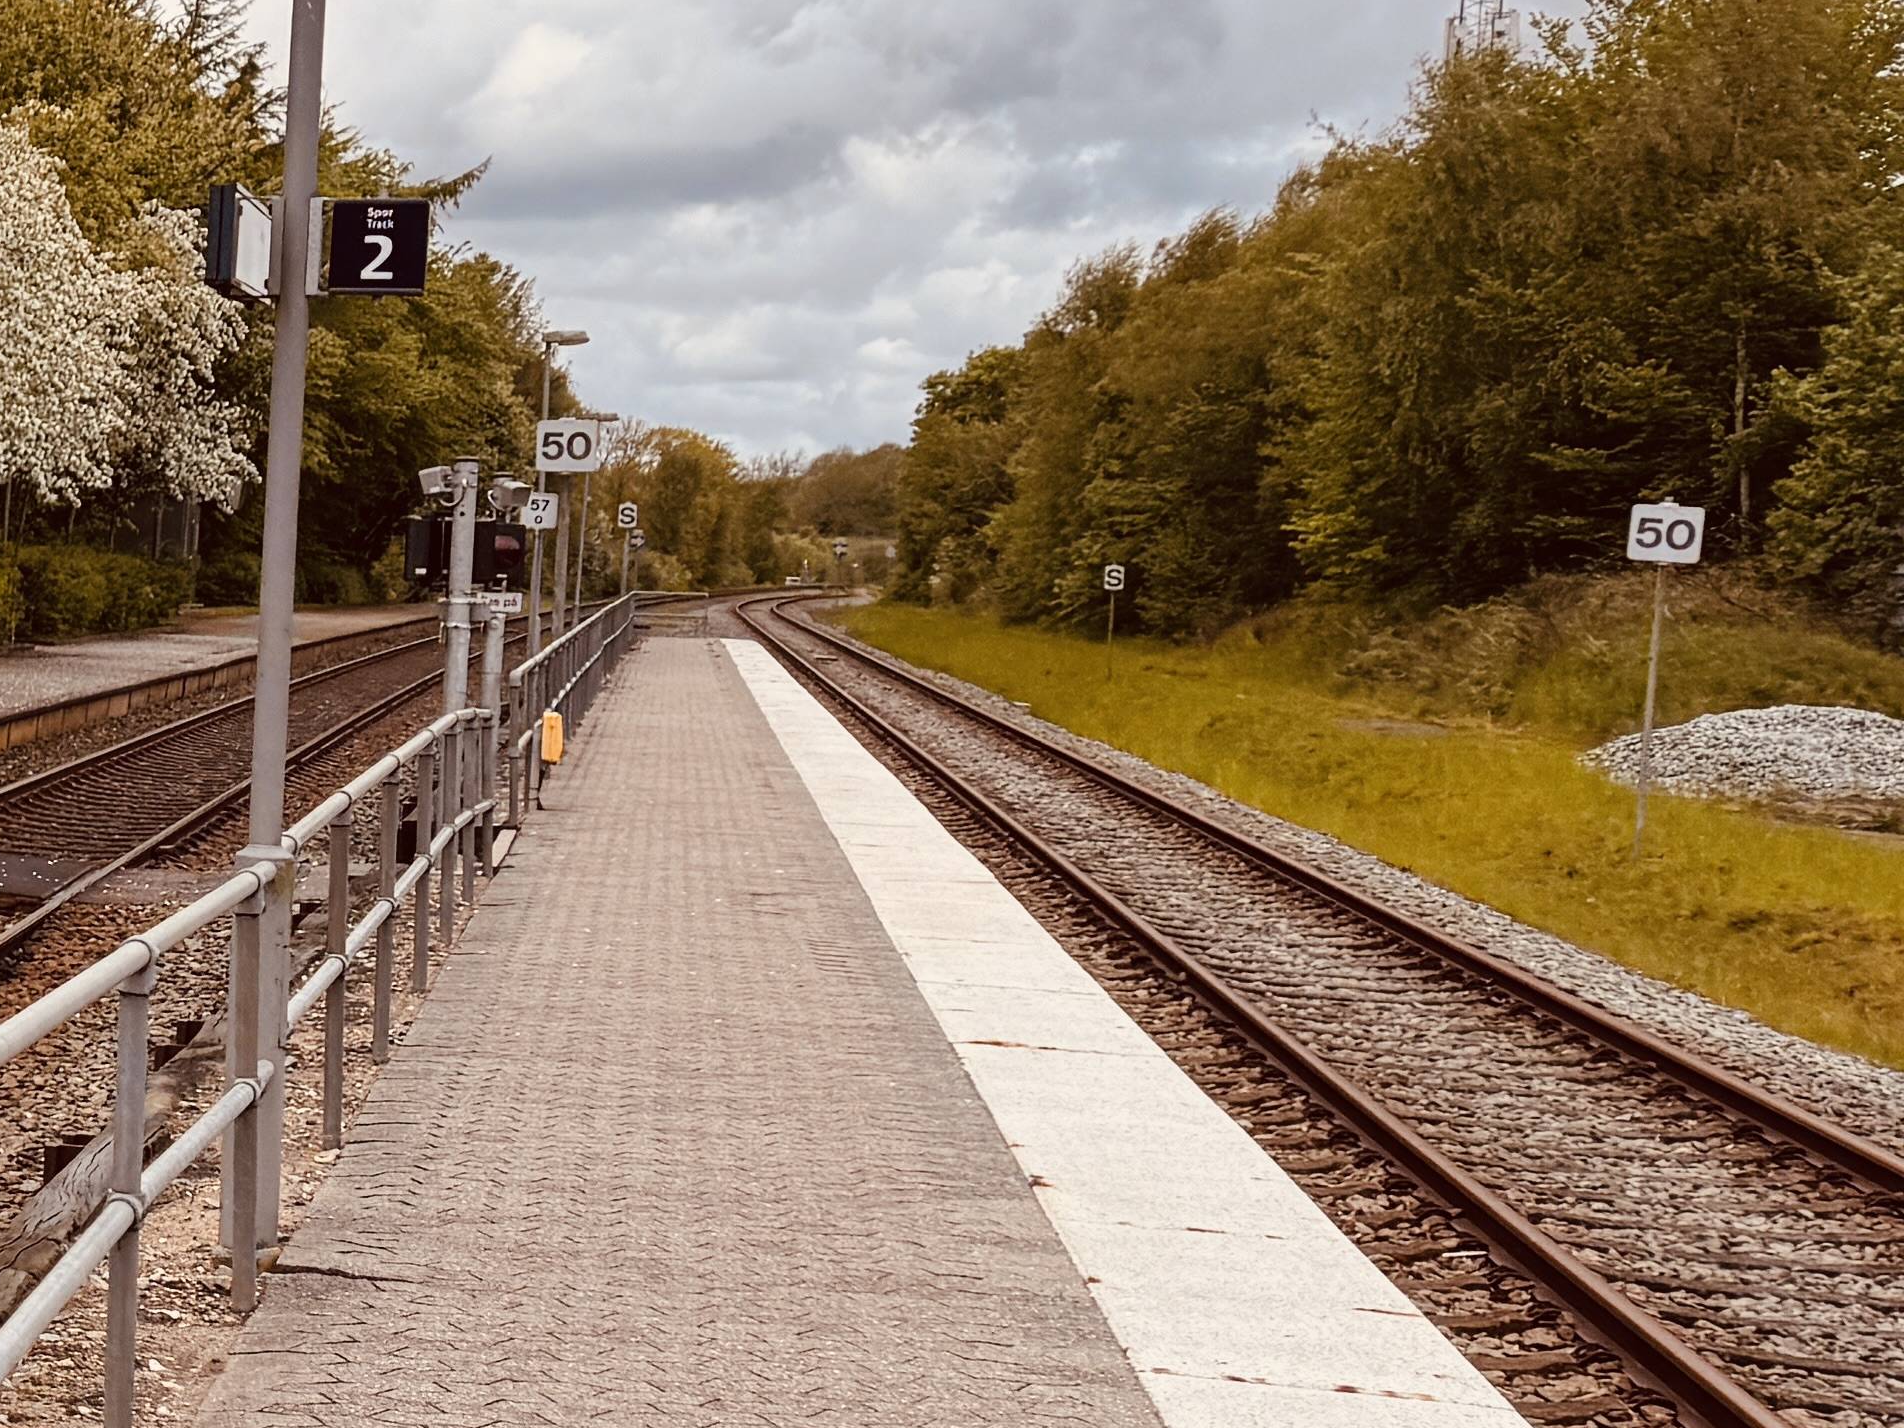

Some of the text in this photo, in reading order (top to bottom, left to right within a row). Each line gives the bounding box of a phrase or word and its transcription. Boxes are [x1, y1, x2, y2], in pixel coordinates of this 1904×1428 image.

[367, 207, 394, 219] Spor
[366, 219, 394, 229] Track
[360, 235, 393, 280] 2
[542, 431, 592, 461] 50
[530, 499, 550, 512] 57
[619, 506, 636, 525] S
[1635, 517, 1696, 551] 50
[1106, 568, 1123, 587] S
